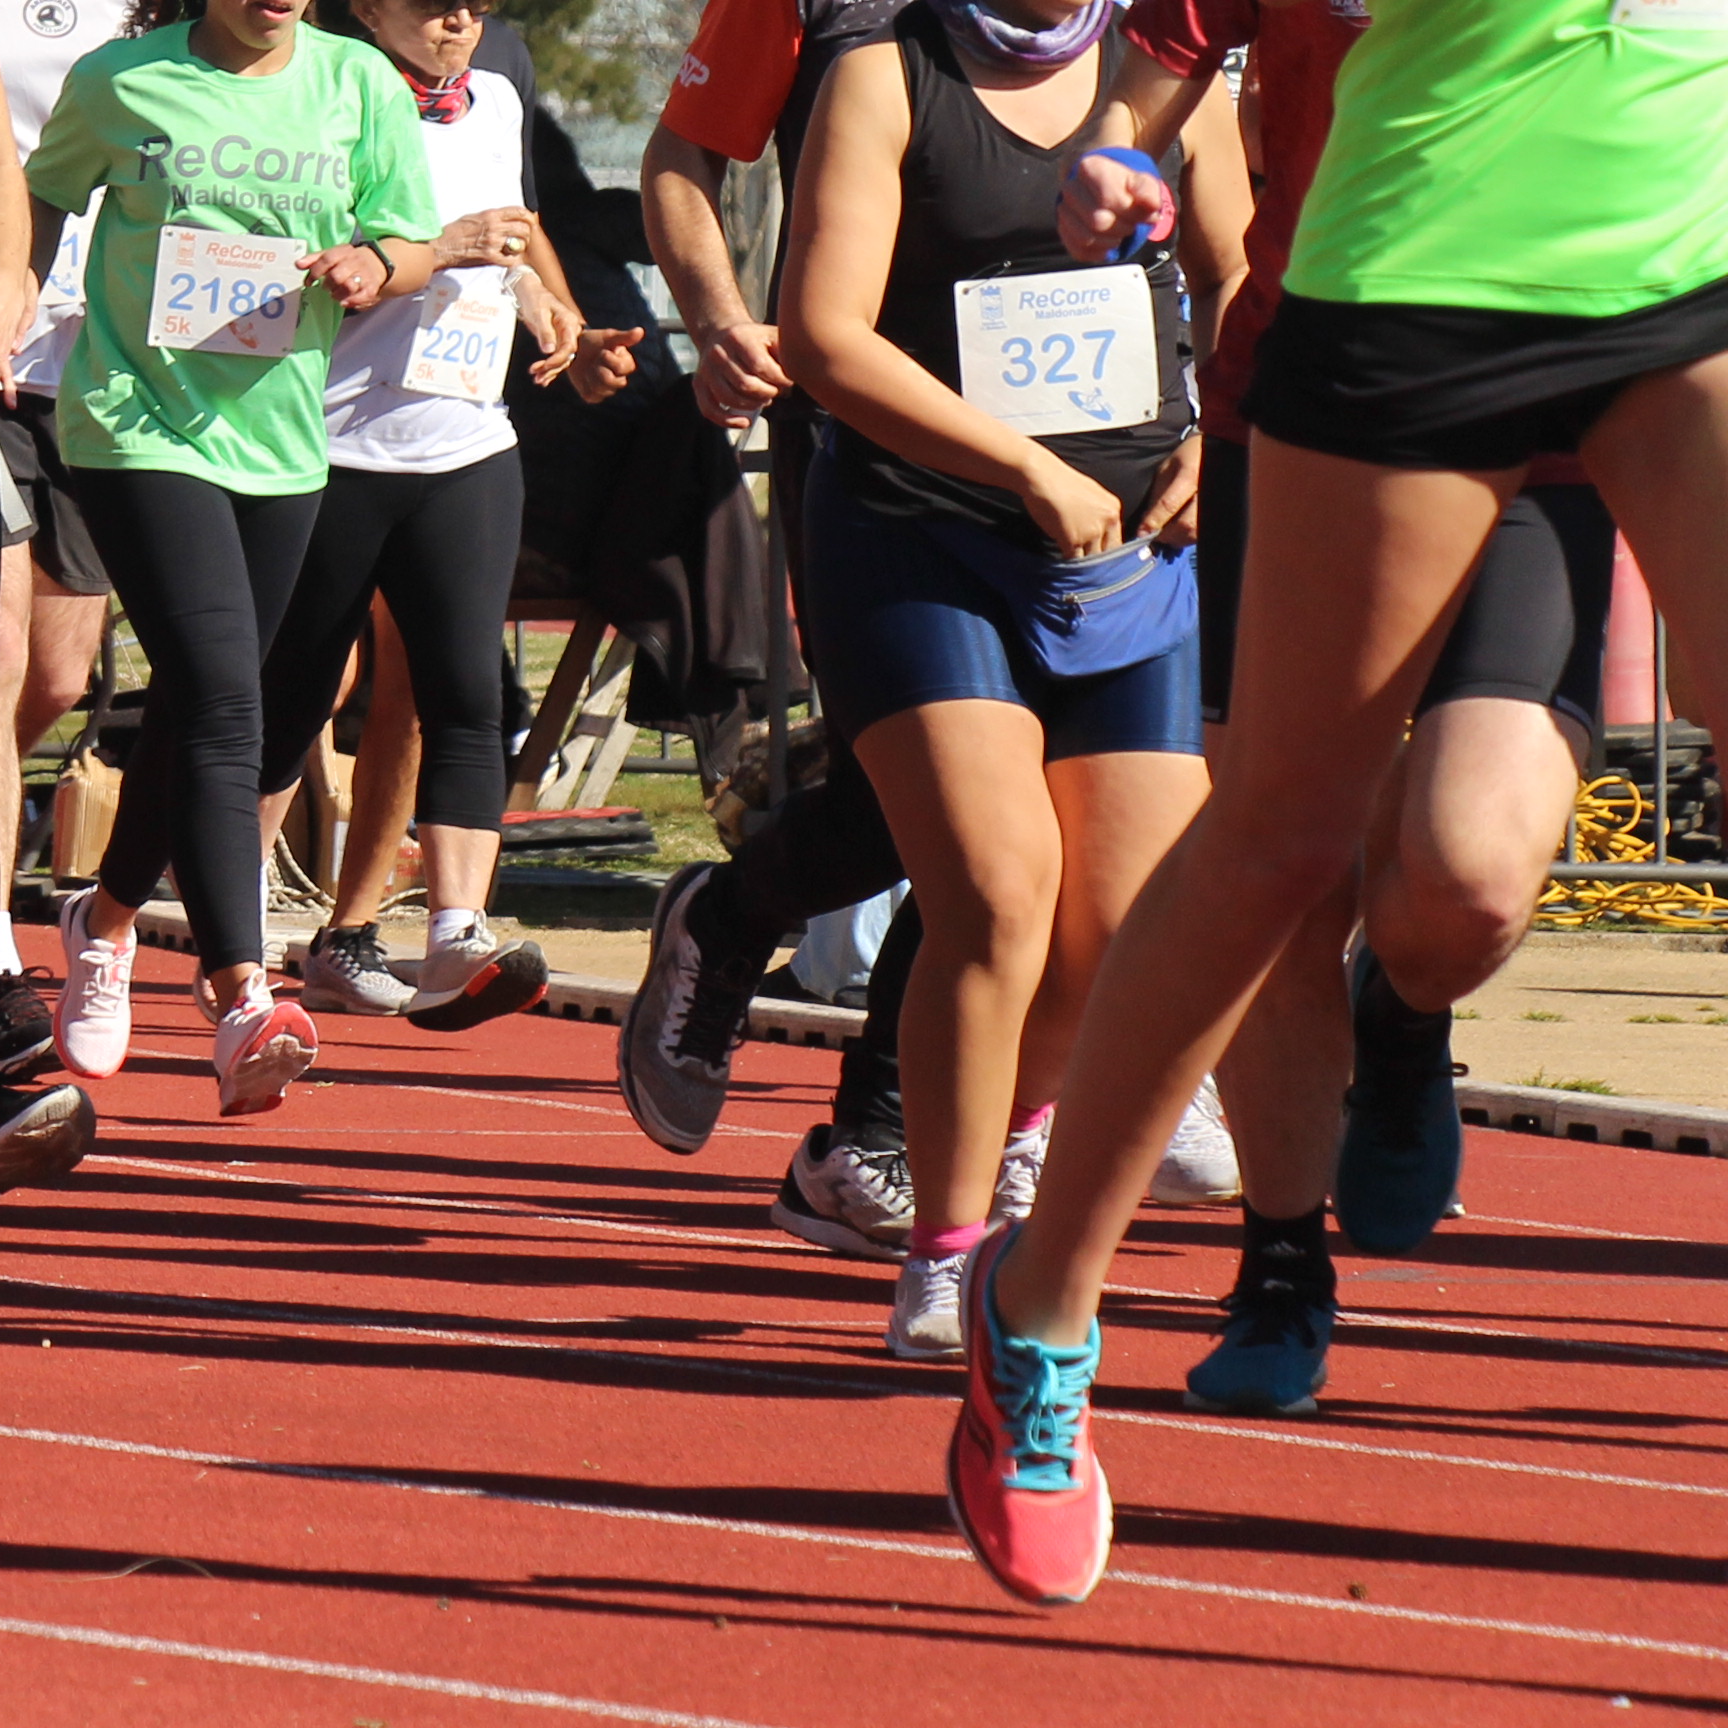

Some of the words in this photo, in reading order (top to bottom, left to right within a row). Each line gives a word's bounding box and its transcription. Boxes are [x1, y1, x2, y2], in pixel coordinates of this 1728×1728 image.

[139, 135, 345, 190] ReCorre
[171, 183, 323, 214] Maldonado
[206, 242, 276, 263] ReCorre
[167, 273, 286, 319] 2186
[1019, 287, 1111, 310] ReCorre
[164, 315, 191, 335] 5k
[1035, 306, 1097, 320] Maldonado
[422, 327, 499, 368] 2201
[1001, 329, 1116, 388] 327
[414, 363, 436, 381] 5k
